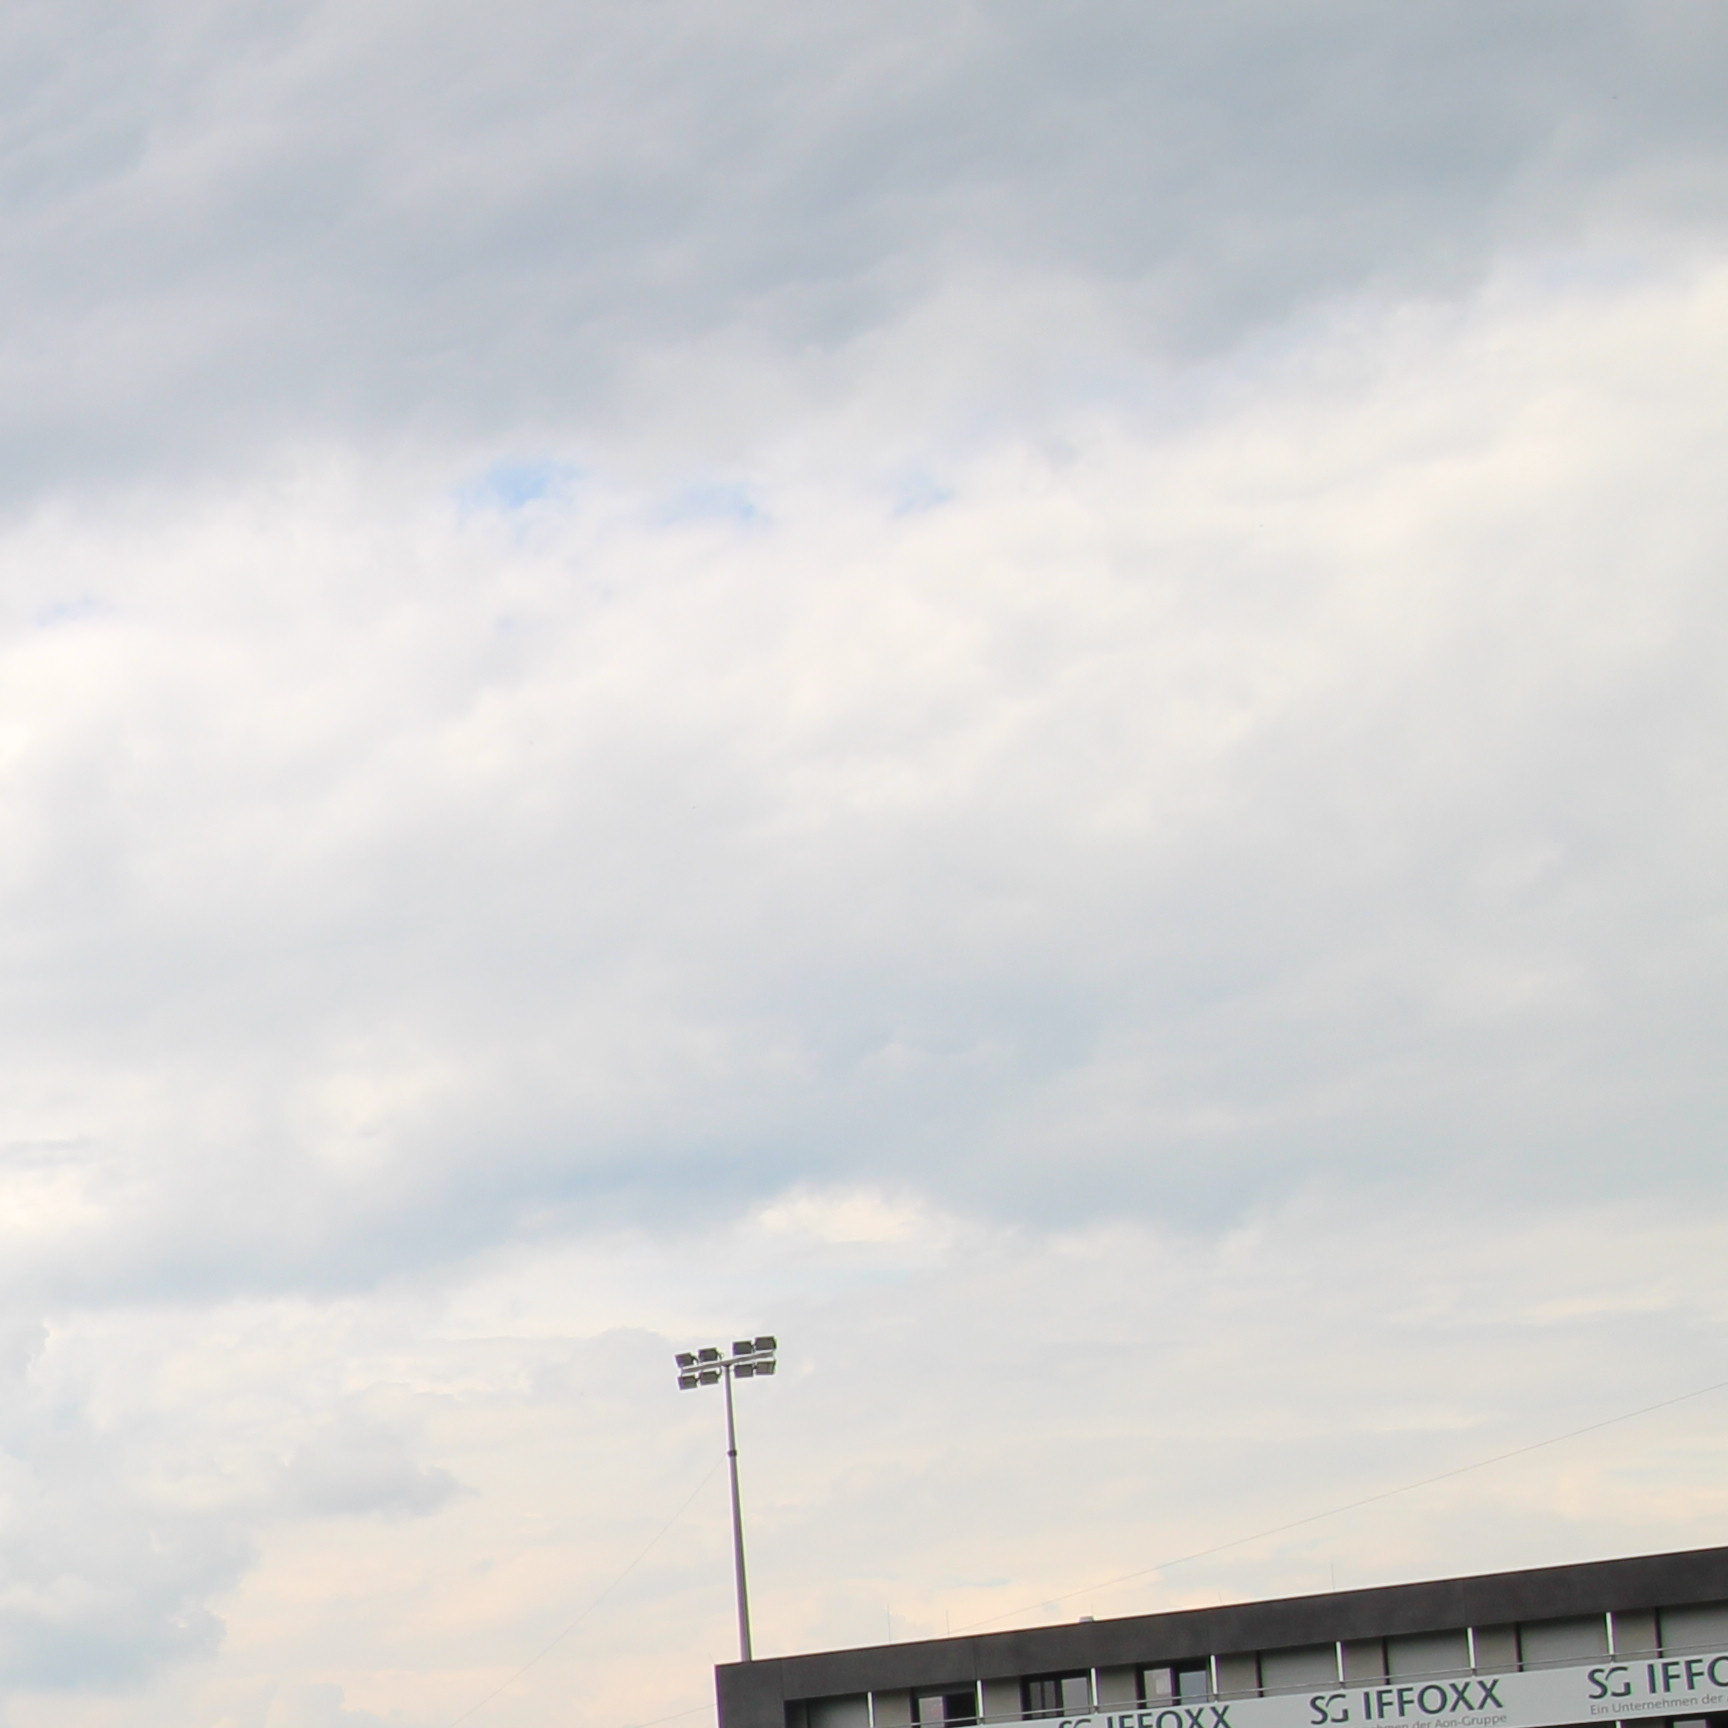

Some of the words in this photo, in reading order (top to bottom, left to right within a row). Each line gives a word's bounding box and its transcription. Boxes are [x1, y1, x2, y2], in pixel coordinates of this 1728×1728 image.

[1363, 1678, 1504, 1721] IFFOXX
[1590, 1703, 1607, 1715] Ein
[1611, 1697, 1698, 1714] Unternehmen
[1701, 1694, 1724, 1704] der
